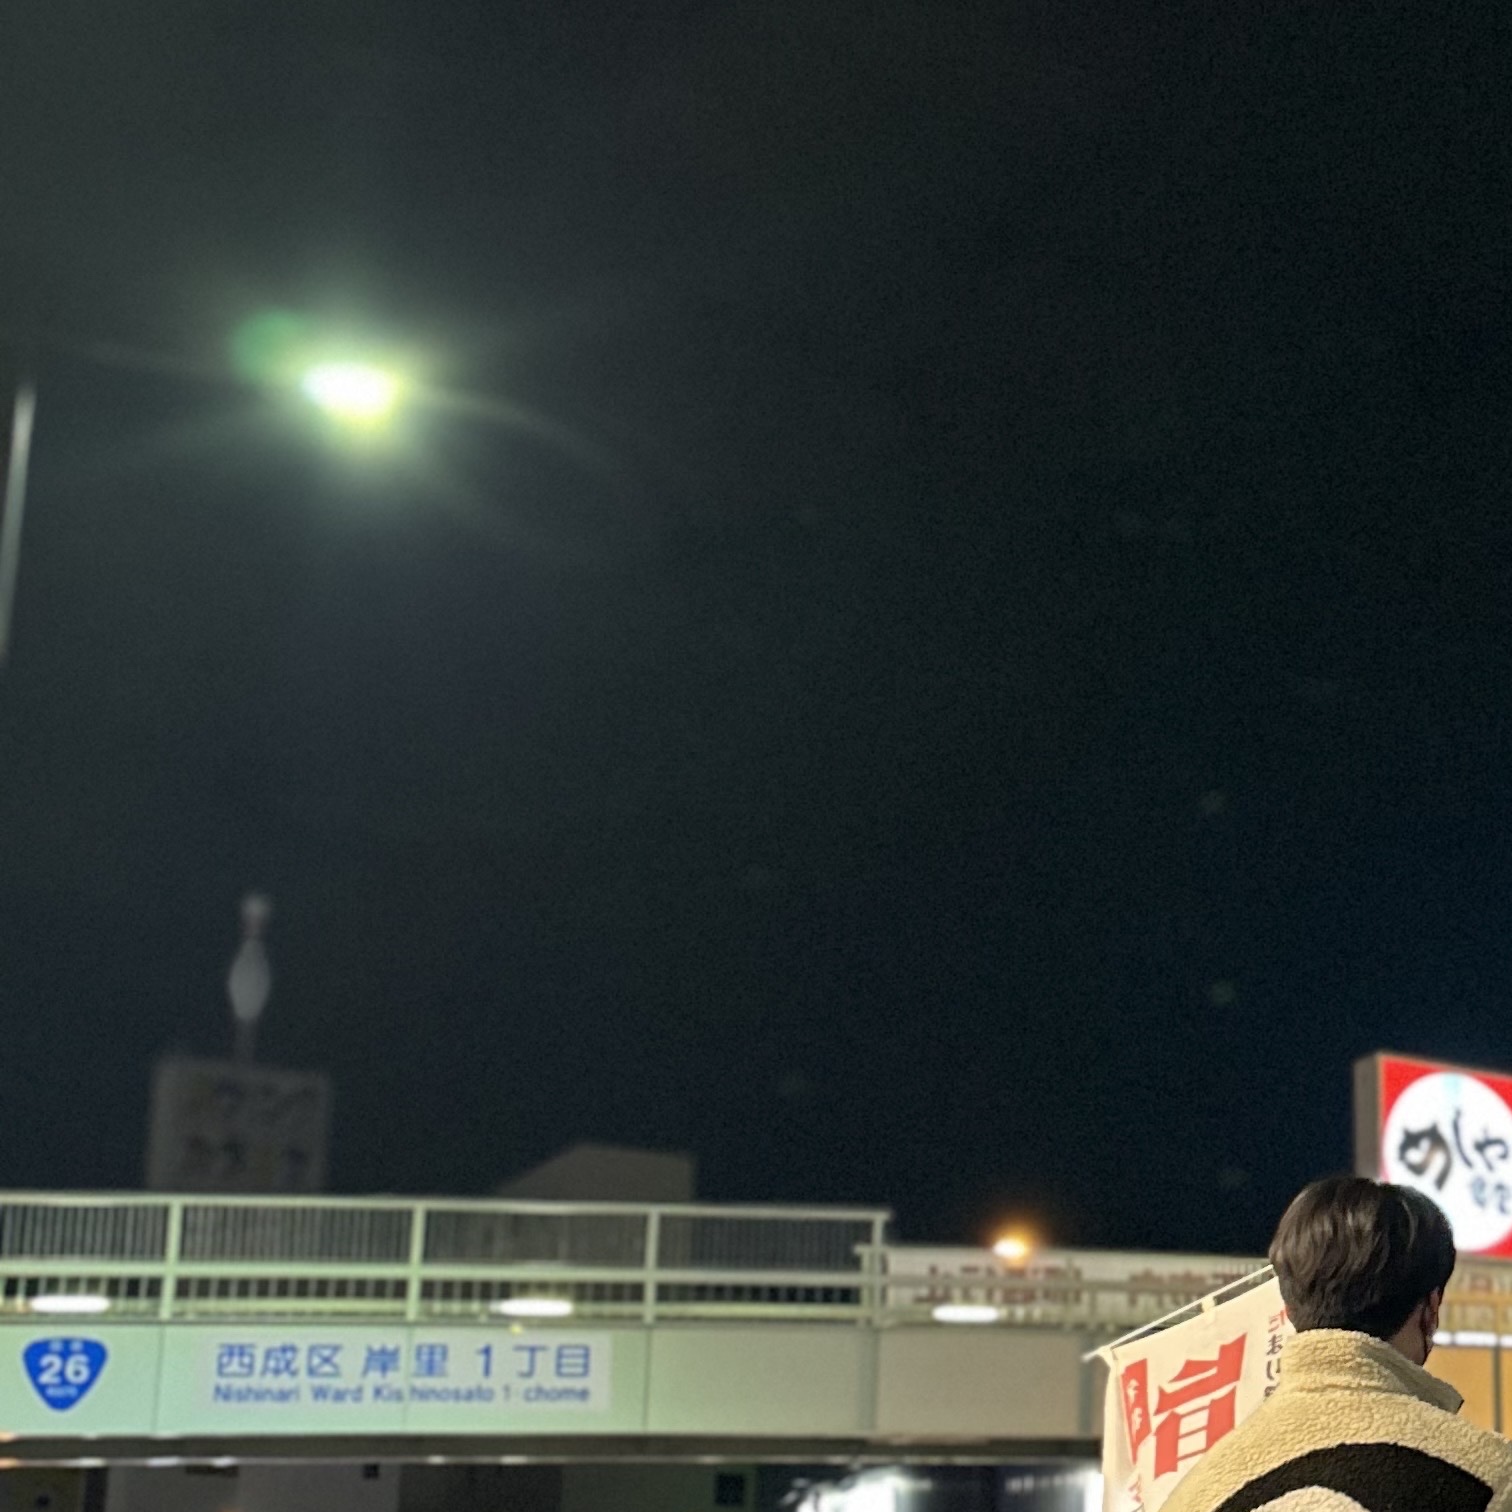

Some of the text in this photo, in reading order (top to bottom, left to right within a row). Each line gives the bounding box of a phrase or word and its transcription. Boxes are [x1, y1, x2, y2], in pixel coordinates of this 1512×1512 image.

[1398, 1107, 1509, 1190] めしや
[39, 1353, 90, 1385] 26
[216, 1342, 343, 1378] 西成区
[311, 1385, 364, 1403] Ward
